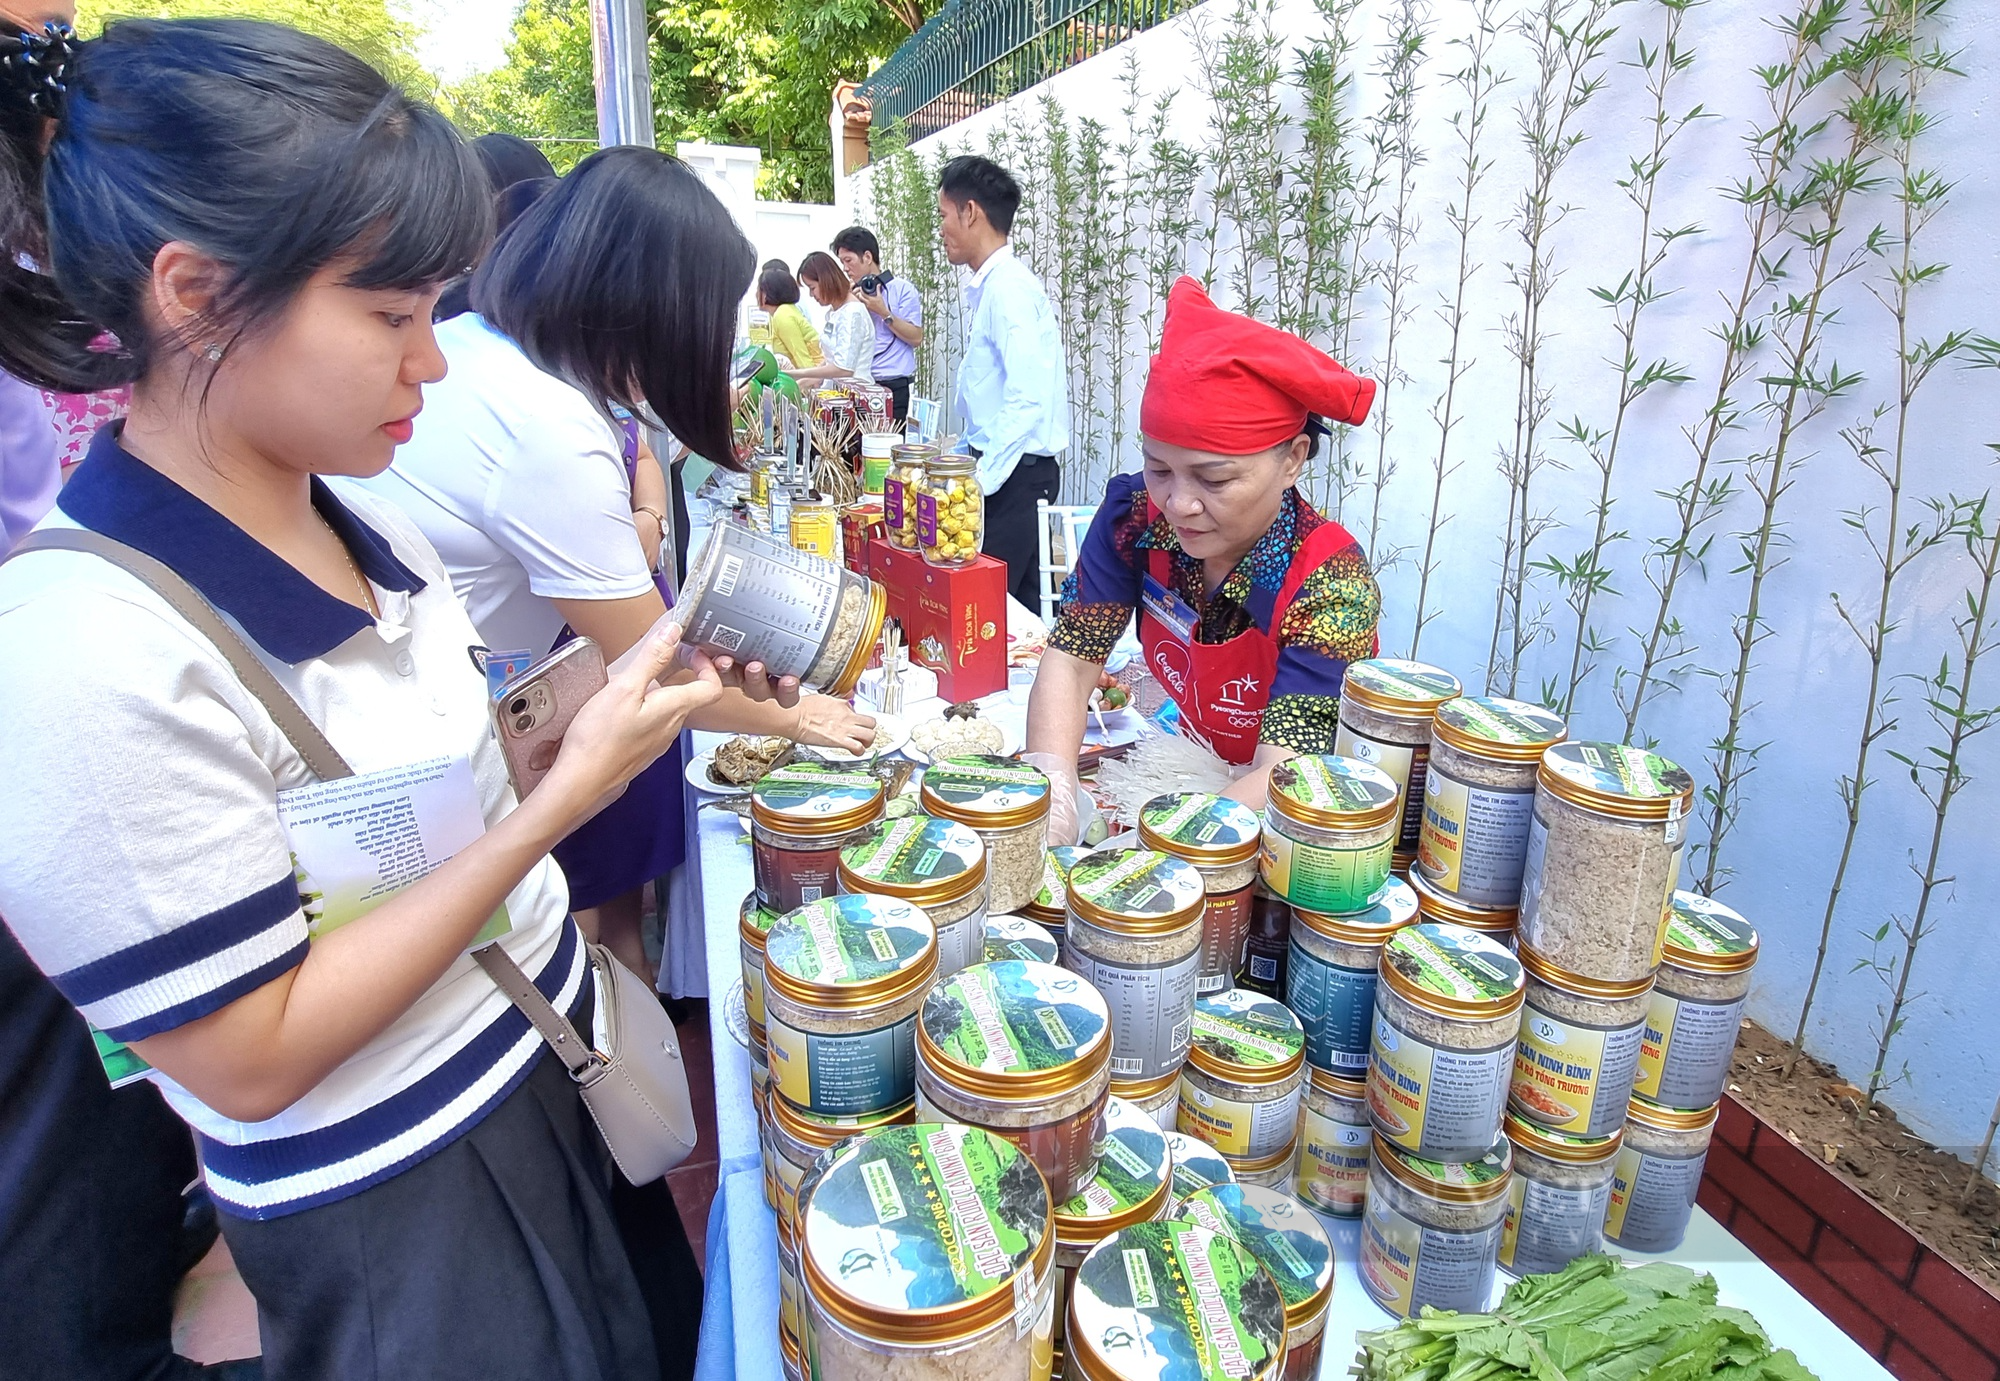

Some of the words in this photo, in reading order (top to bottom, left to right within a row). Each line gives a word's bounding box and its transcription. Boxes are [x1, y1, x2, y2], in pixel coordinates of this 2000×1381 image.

[1211, 703, 1258, 716] PyeongChang
[324, 785, 342, 794] vùng
[386, 779, 411, 791] nghiệm
[413, 776, 428, 784] kinh
[295, 793, 311, 802] Tam
[324, 796, 337, 805] ông
[338, 794, 350, 802] cha
[351, 791, 362, 799] mà
[1472, 793, 1489, 802] THÔNG
[1501, 797, 1518, 805] CHUNG
[1439, 816, 1458, 835] BÌNH
[1249, 1037, 1267, 1049] NINH
[1268, 1043, 1286, 1056] BÌNH
[1645, 1027, 1663, 1043] ÌNH
[1437, 1055, 1456, 1063] THÔNG
[1468, 1058, 1485, 1066] CHUNG
[1519, 1041, 1537, 1063] SẢN
[1538, 1055, 1563, 1072] NINH
[1565, 1058, 1592, 1081] BÌNH
[1397, 1073, 1421, 1096] BÌNH
[1535, 1069, 1556, 1087] TỔNG
[1557, 1078, 1589, 1096] TRƯỜNG
[1391, 1087, 1419, 1111] TRƯỜNG
[924, 1128, 954, 1157] BÌNH
[936, 1152, 965, 1181] NINH
[1308, 1142, 1323, 1160] ĐẶC
[1325, 1152, 1344, 1167] SẢN
[1345, 1157, 1367, 1168] NINH
[942, 1176, 972, 1199] CÁ
[1088, 1184, 1116, 1212] BÌNH
[947, 1192, 983, 1228] RUỐC
[928, 1198, 961, 1254] OCOP.NB.
[960, 1222, 995, 1254] SẢN
[1425, 1233, 1444, 1242] THÔNG
[1175, 1228, 1202, 1255] BÌNH
[973, 1246, 1010, 1279] ĐẶC
[1187, 1252, 1211, 1280] NINH
[1388, 1242, 1410, 1267] BÌNH
[1382, 1256, 1409, 1281] TRƯỜNG
[1192, 1277, 1217, 1298] CÁ
[1180, 1295, 1206, 1347] OCOP.NB.
[1197, 1296, 1228, 1327] RUỐC
[1207, 1325, 1237, 1352] SẢN
[1218, 1349, 1250, 1378] ĐẶC
